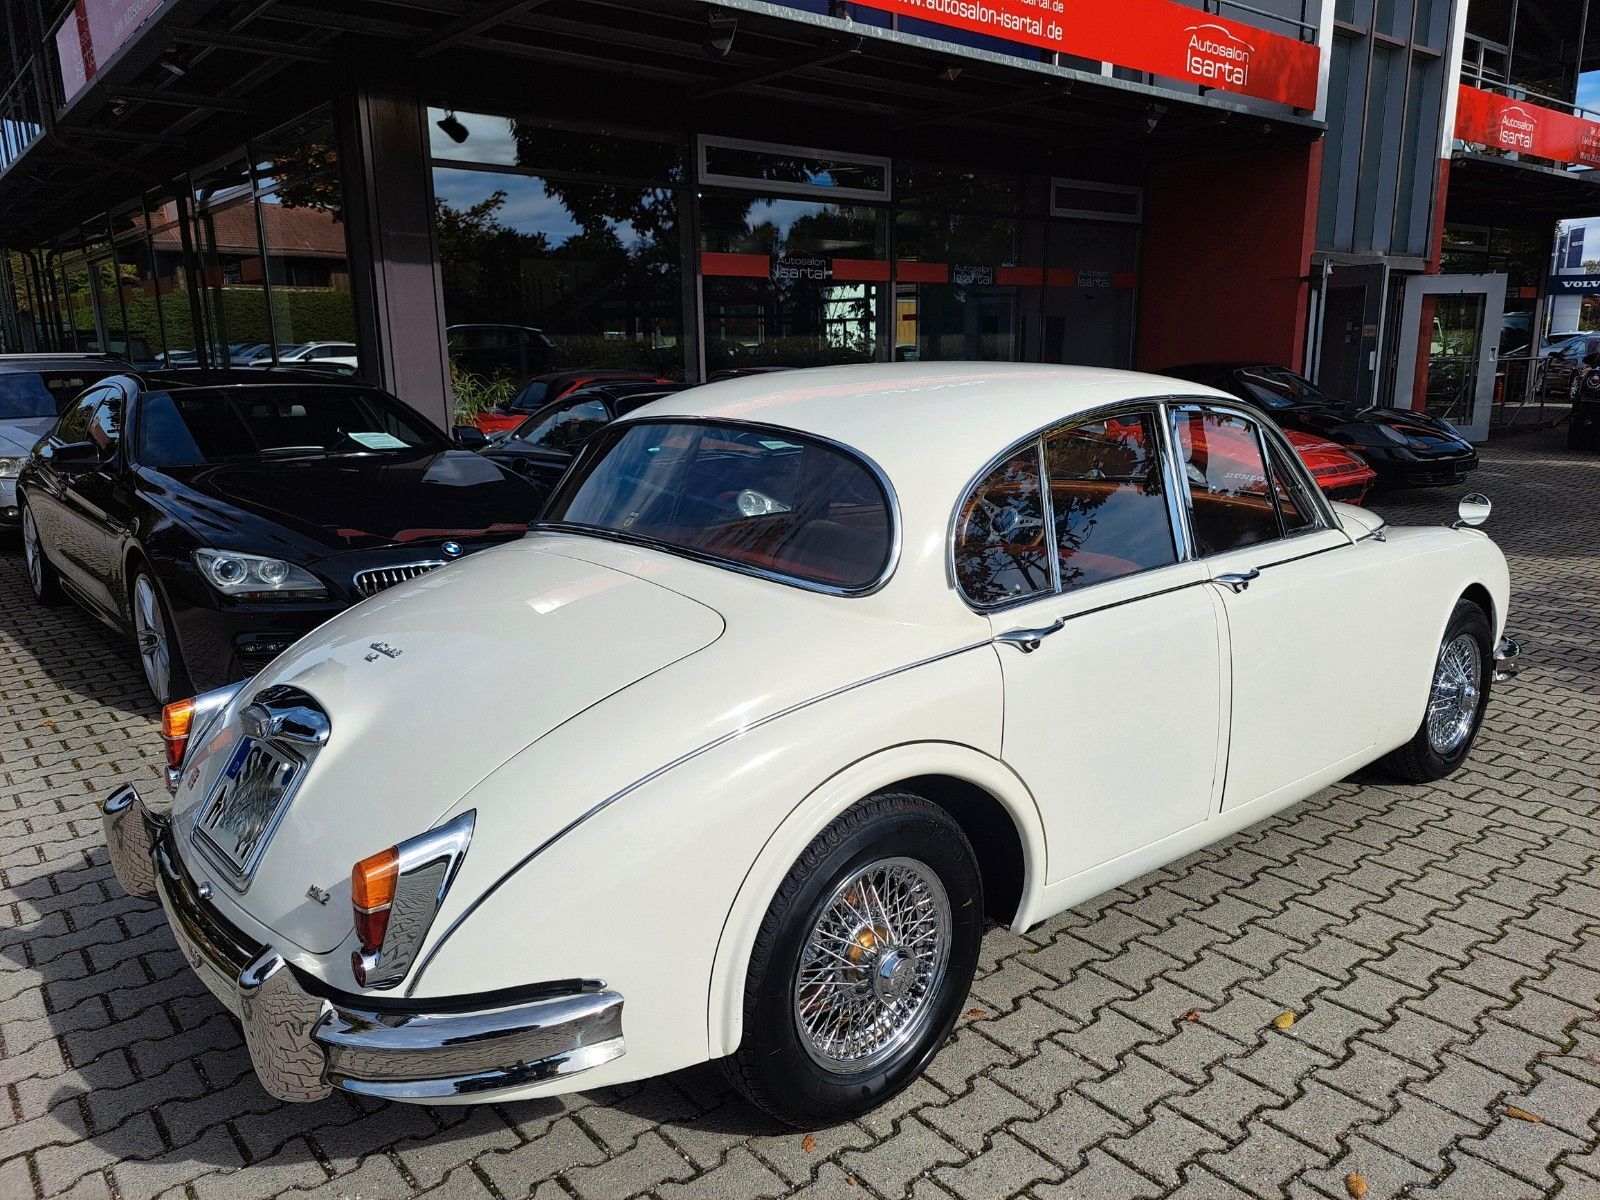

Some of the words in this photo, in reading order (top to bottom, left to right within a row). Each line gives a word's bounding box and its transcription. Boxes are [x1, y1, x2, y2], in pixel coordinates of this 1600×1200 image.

[1188, 34, 1249, 63] Autosalon
[1186, 48, 1249, 86] Isartal
[1501, 114, 1534, 133] Autosalon
[1500, 125, 1533, 148] Isartal
[777, 255, 827, 267] Autosalon
[776, 264, 827, 280] Isartal
